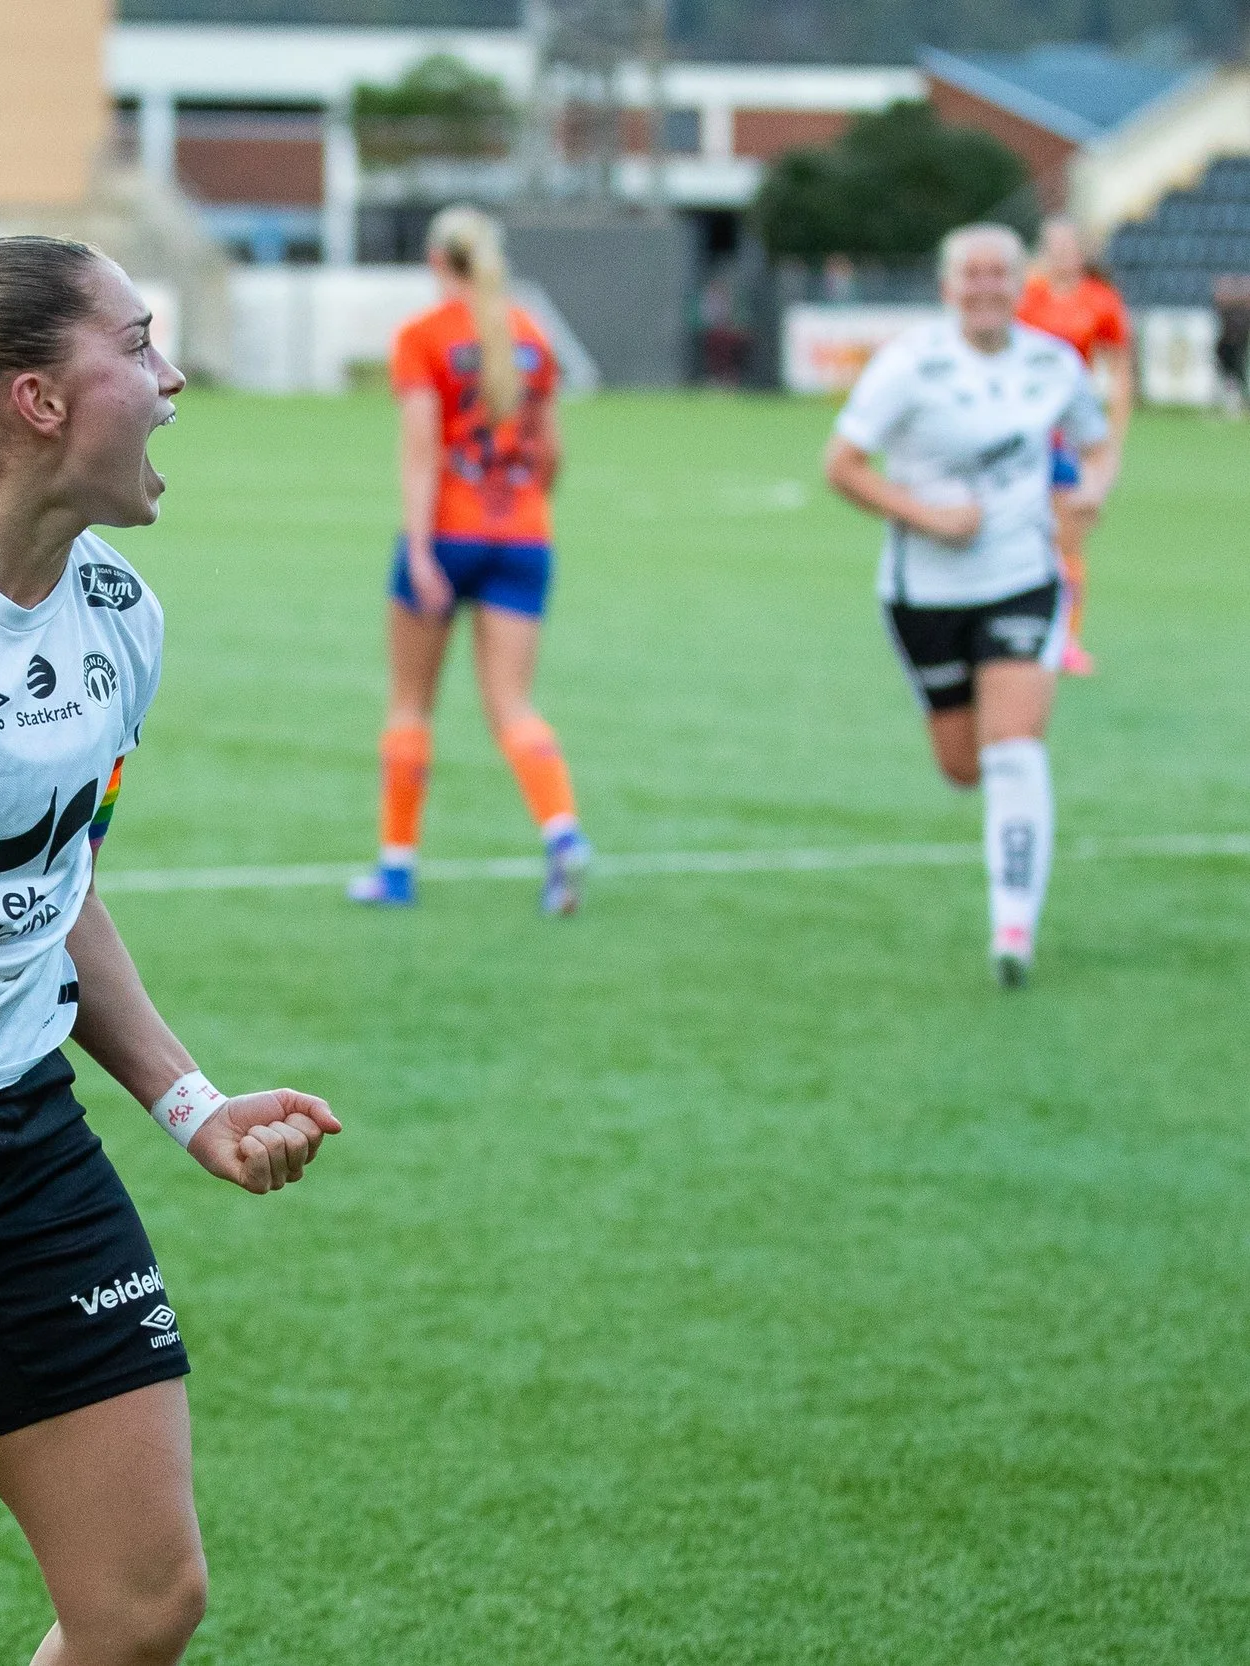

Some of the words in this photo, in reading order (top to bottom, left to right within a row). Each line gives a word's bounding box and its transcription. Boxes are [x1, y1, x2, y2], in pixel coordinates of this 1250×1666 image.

[16, 701, 82, 727] Statkraft
[71, 1265, 164, 1315] Veidek
[151, 1331, 181, 1348] umbr
